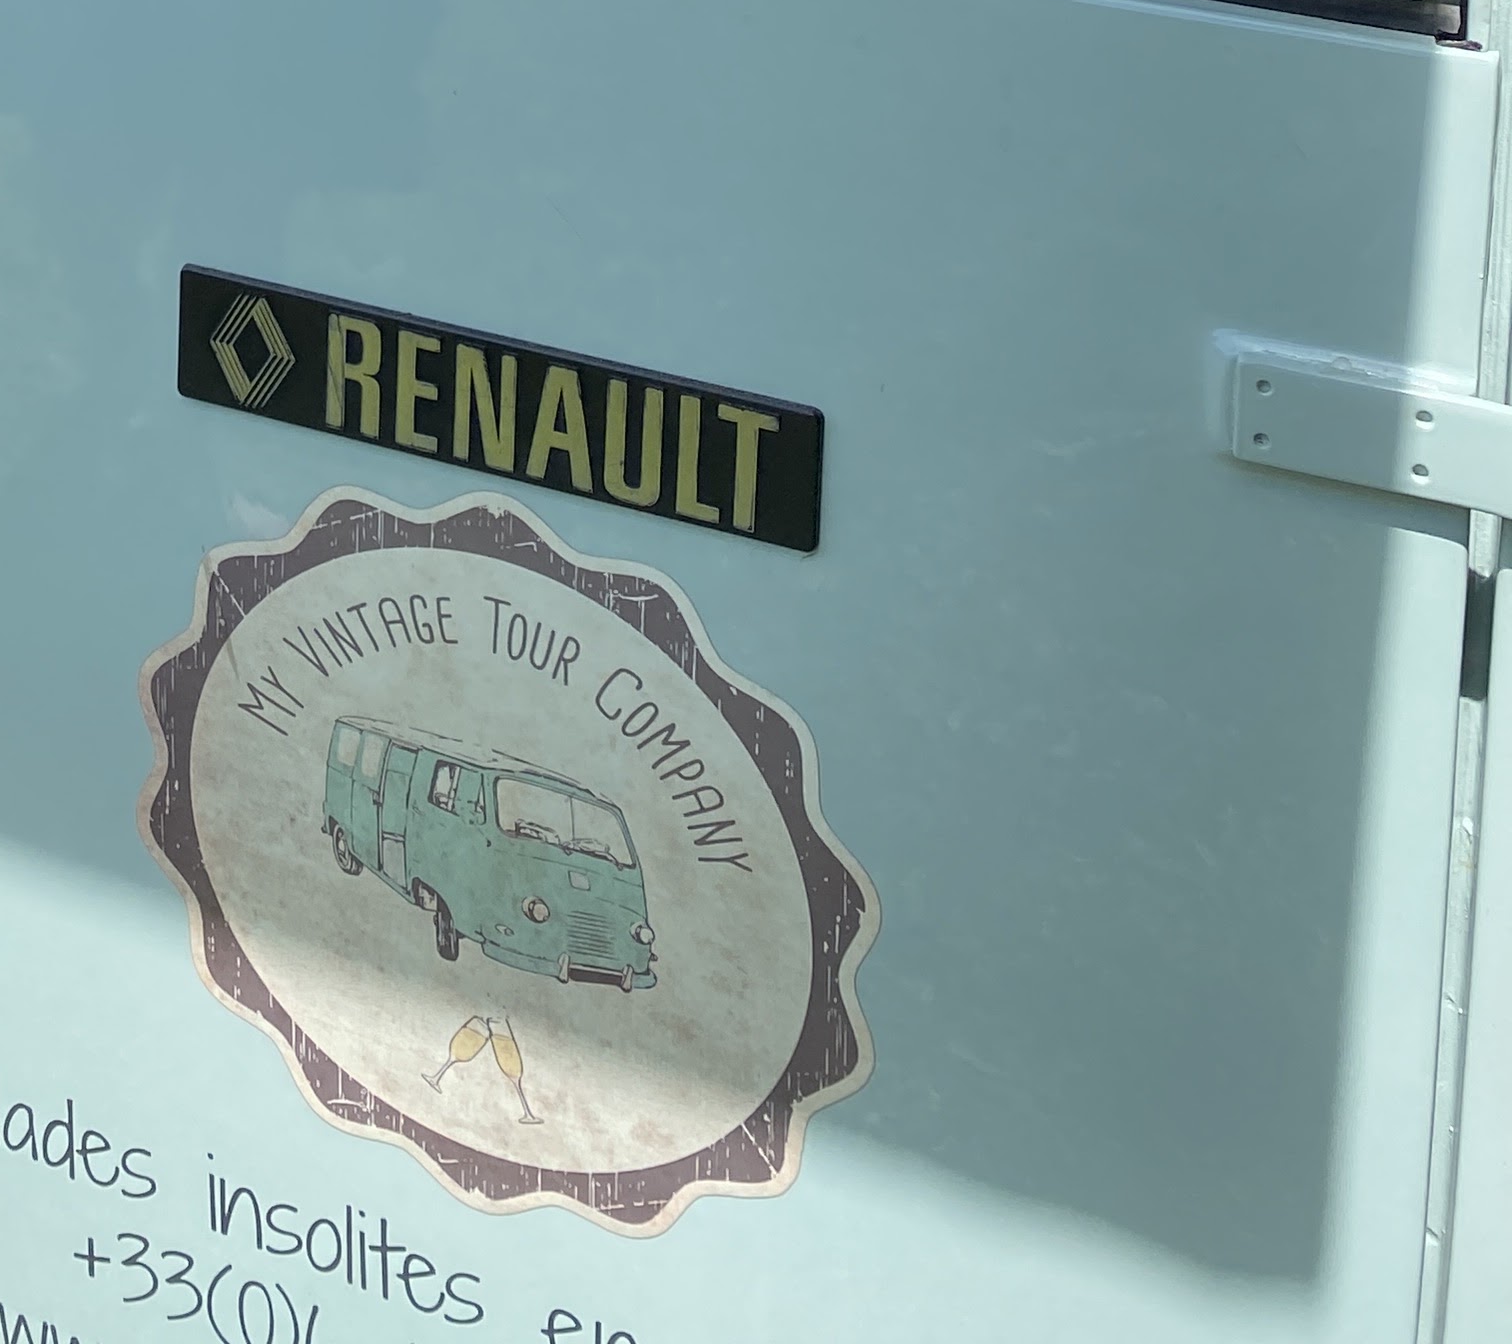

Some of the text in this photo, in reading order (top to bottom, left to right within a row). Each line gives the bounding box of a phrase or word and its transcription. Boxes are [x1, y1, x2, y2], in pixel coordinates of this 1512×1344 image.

[324, 312, 780, 534] RENAULT
[237, 593, 753, 874] MY VINTAGE TOUR COMPANY
[207, 1151, 484, 1326] insolites
